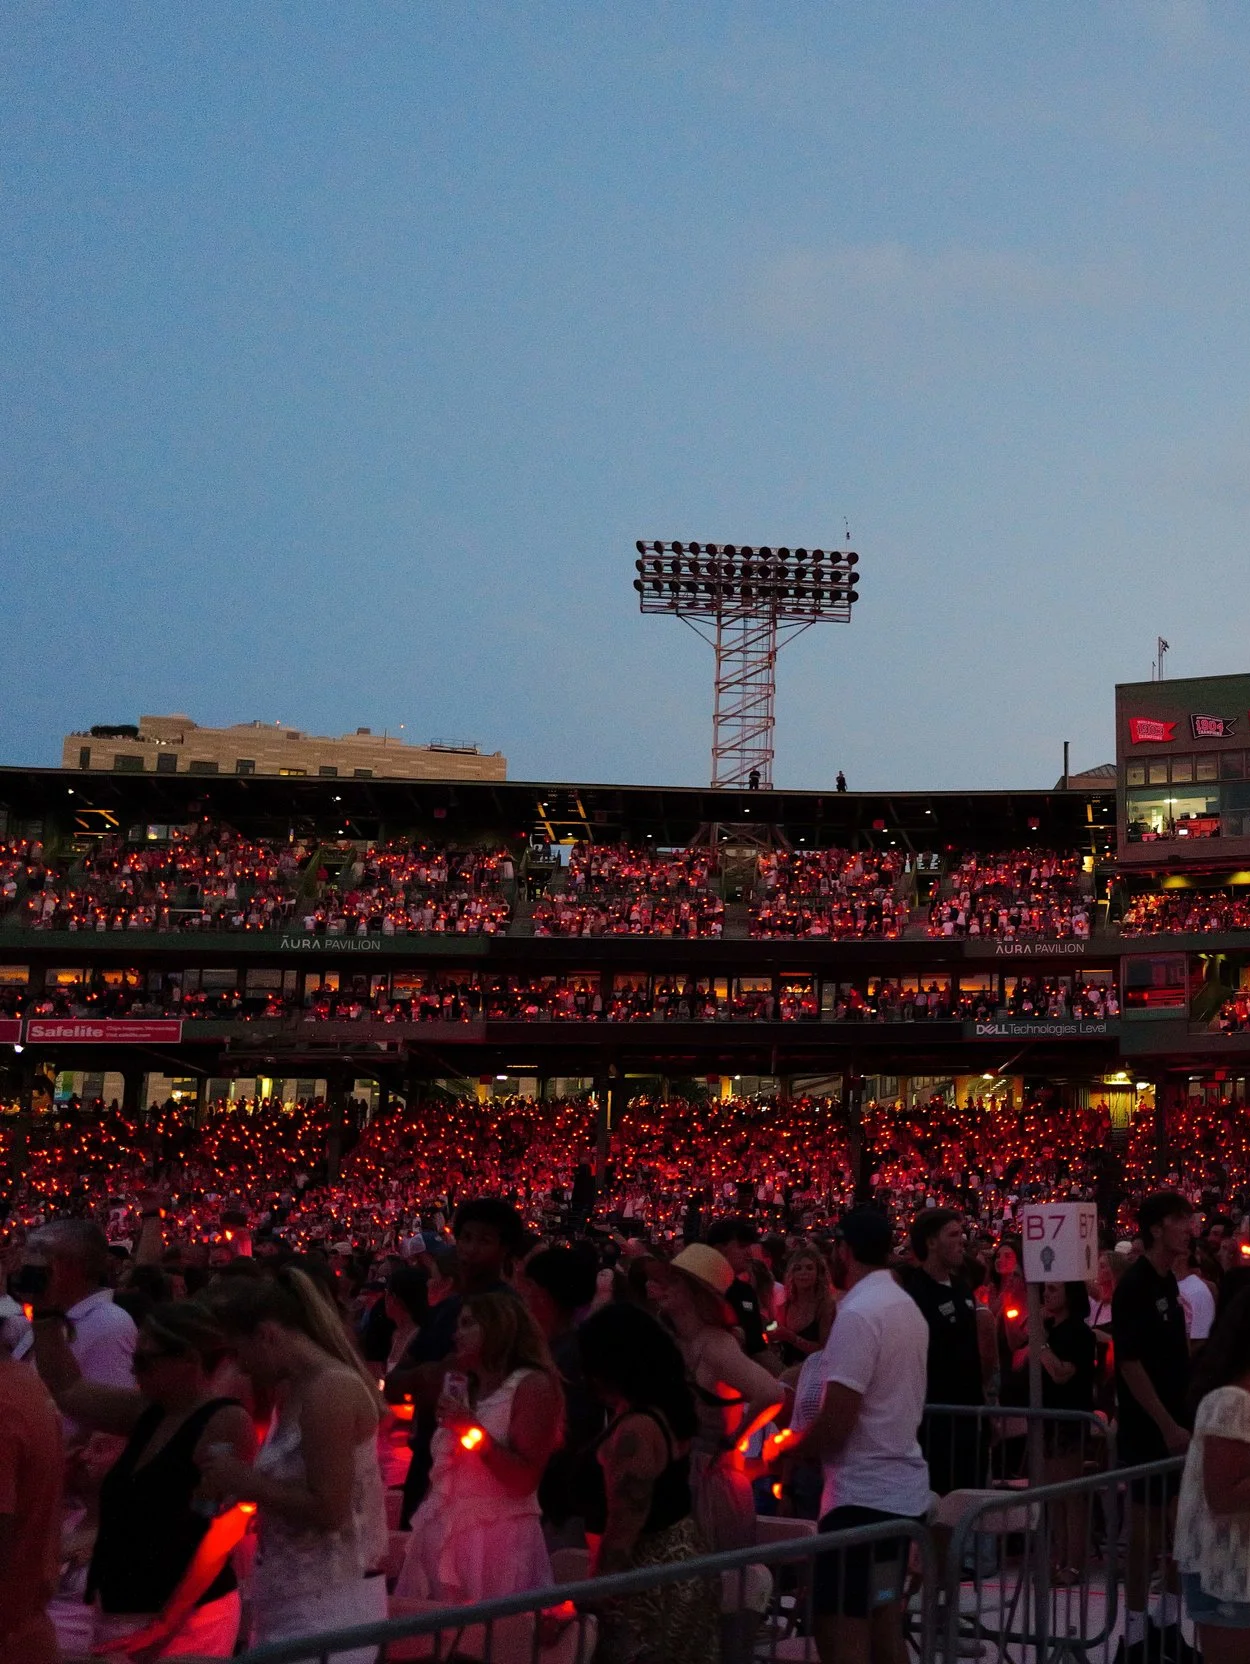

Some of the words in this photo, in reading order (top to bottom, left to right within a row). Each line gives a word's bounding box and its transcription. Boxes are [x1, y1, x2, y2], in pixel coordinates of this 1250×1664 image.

[1195, 720, 1224, 732] 1904
[325, 940, 380, 950] PAVILION
[1035, 944, 1084, 953] PAVILION
[31, 1025, 104, 1037] Safelite
[1080, 1023, 1106, 1033] Level
[1027, 1215, 1066, 1240] B7
[1080, 1214, 1094, 1238] B7
